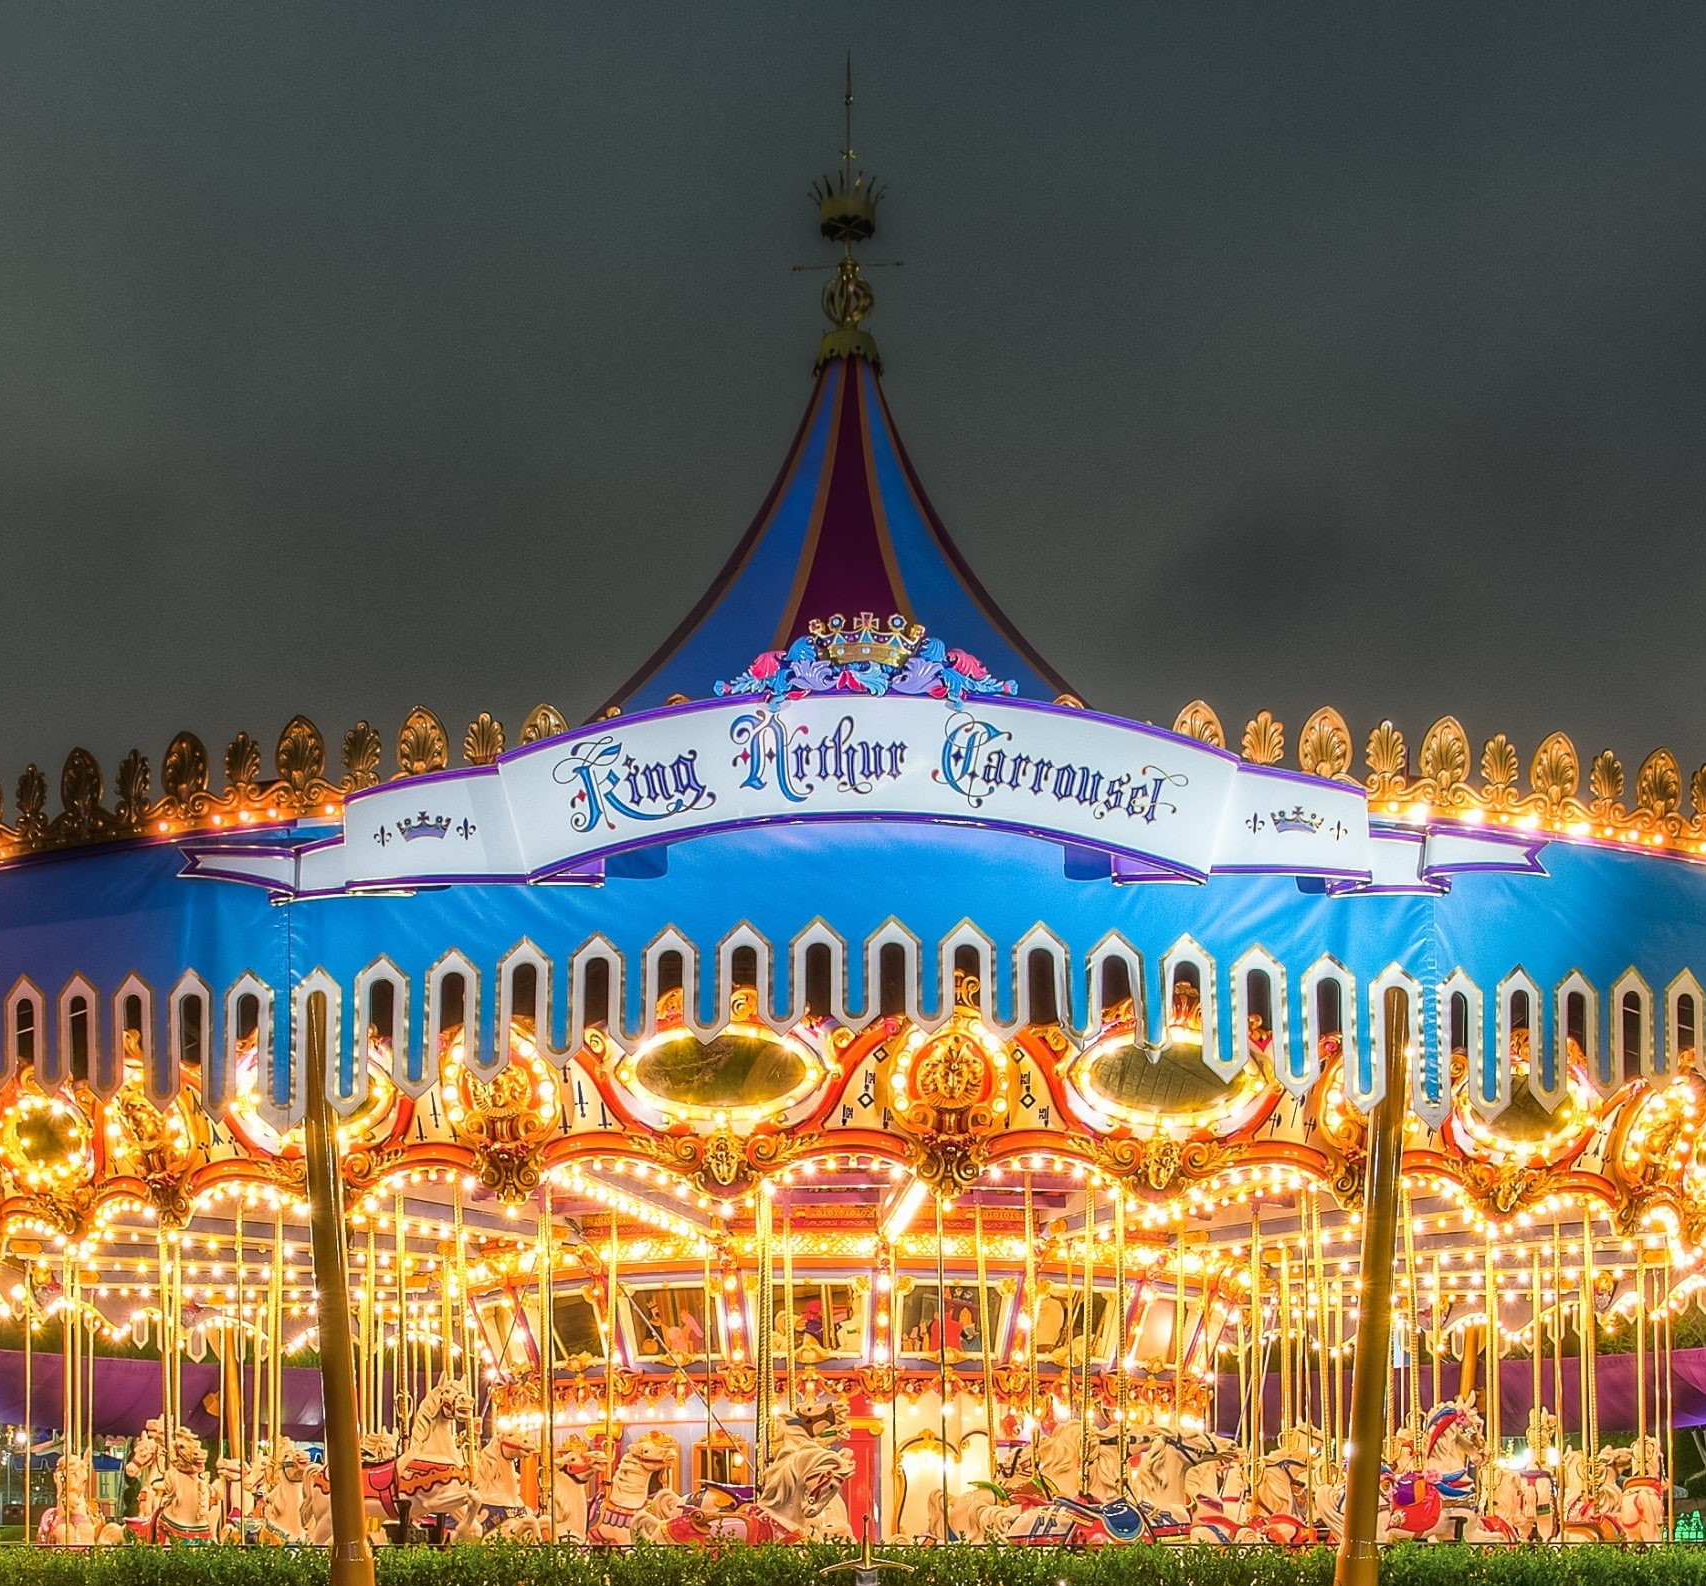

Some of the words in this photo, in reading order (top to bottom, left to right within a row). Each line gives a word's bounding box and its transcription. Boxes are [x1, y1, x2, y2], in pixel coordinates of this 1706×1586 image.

[552, 736, 716, 832] King
[730, 710, 908, 802] Arthur
[931, 712, 1189, 824] Carrousel
